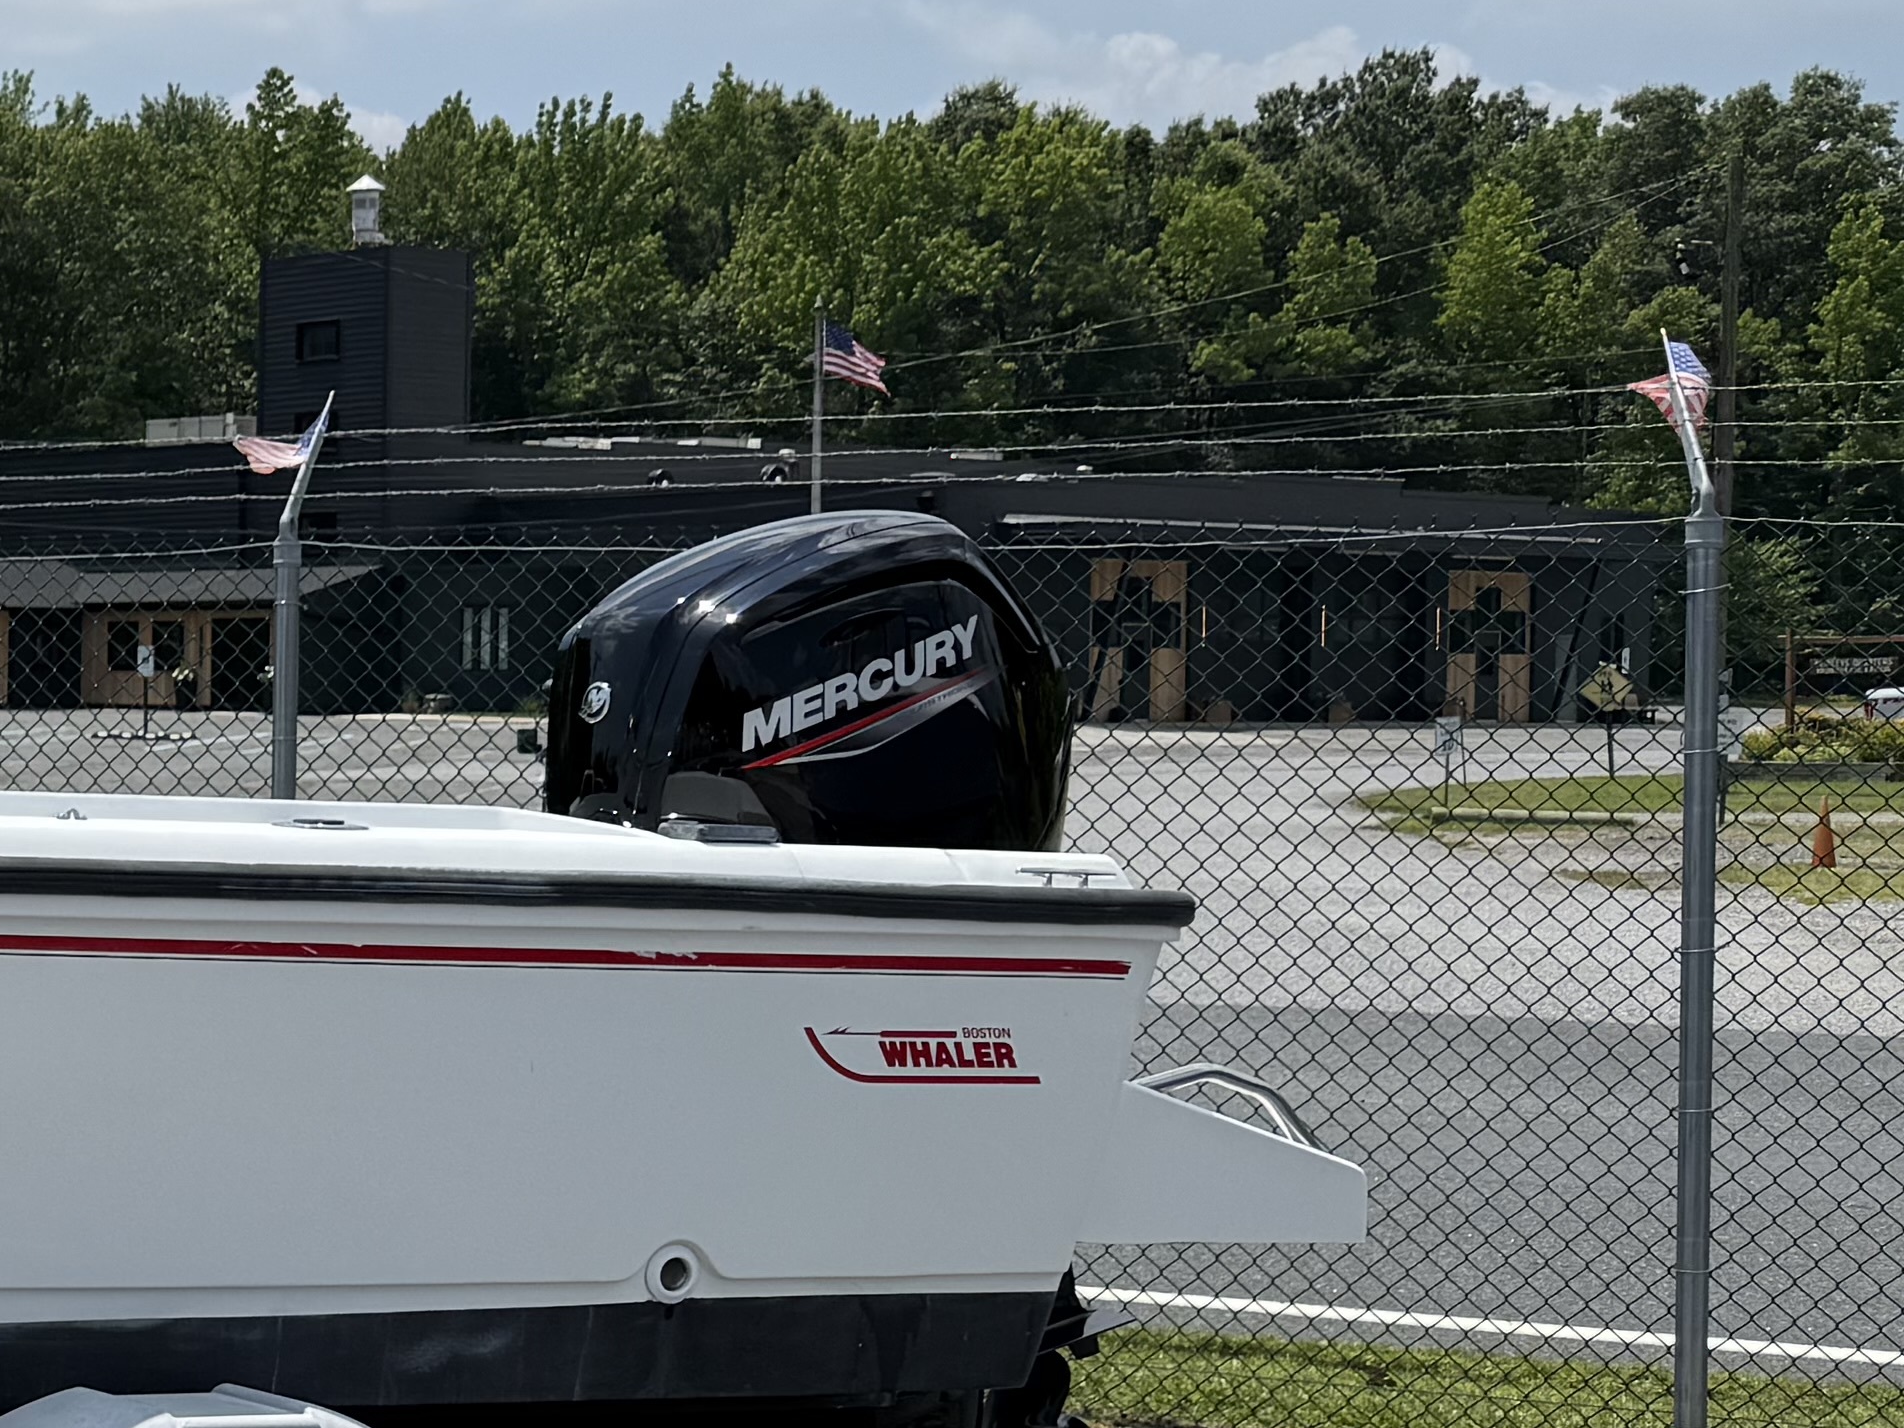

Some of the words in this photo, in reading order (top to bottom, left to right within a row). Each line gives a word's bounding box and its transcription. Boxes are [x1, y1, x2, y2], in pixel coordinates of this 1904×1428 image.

[742, 614, 978, 752] MERCURY
[961, 1027, 1012, 1039] BOSTON
[878, 1040, 1019, 1069] WHALER
